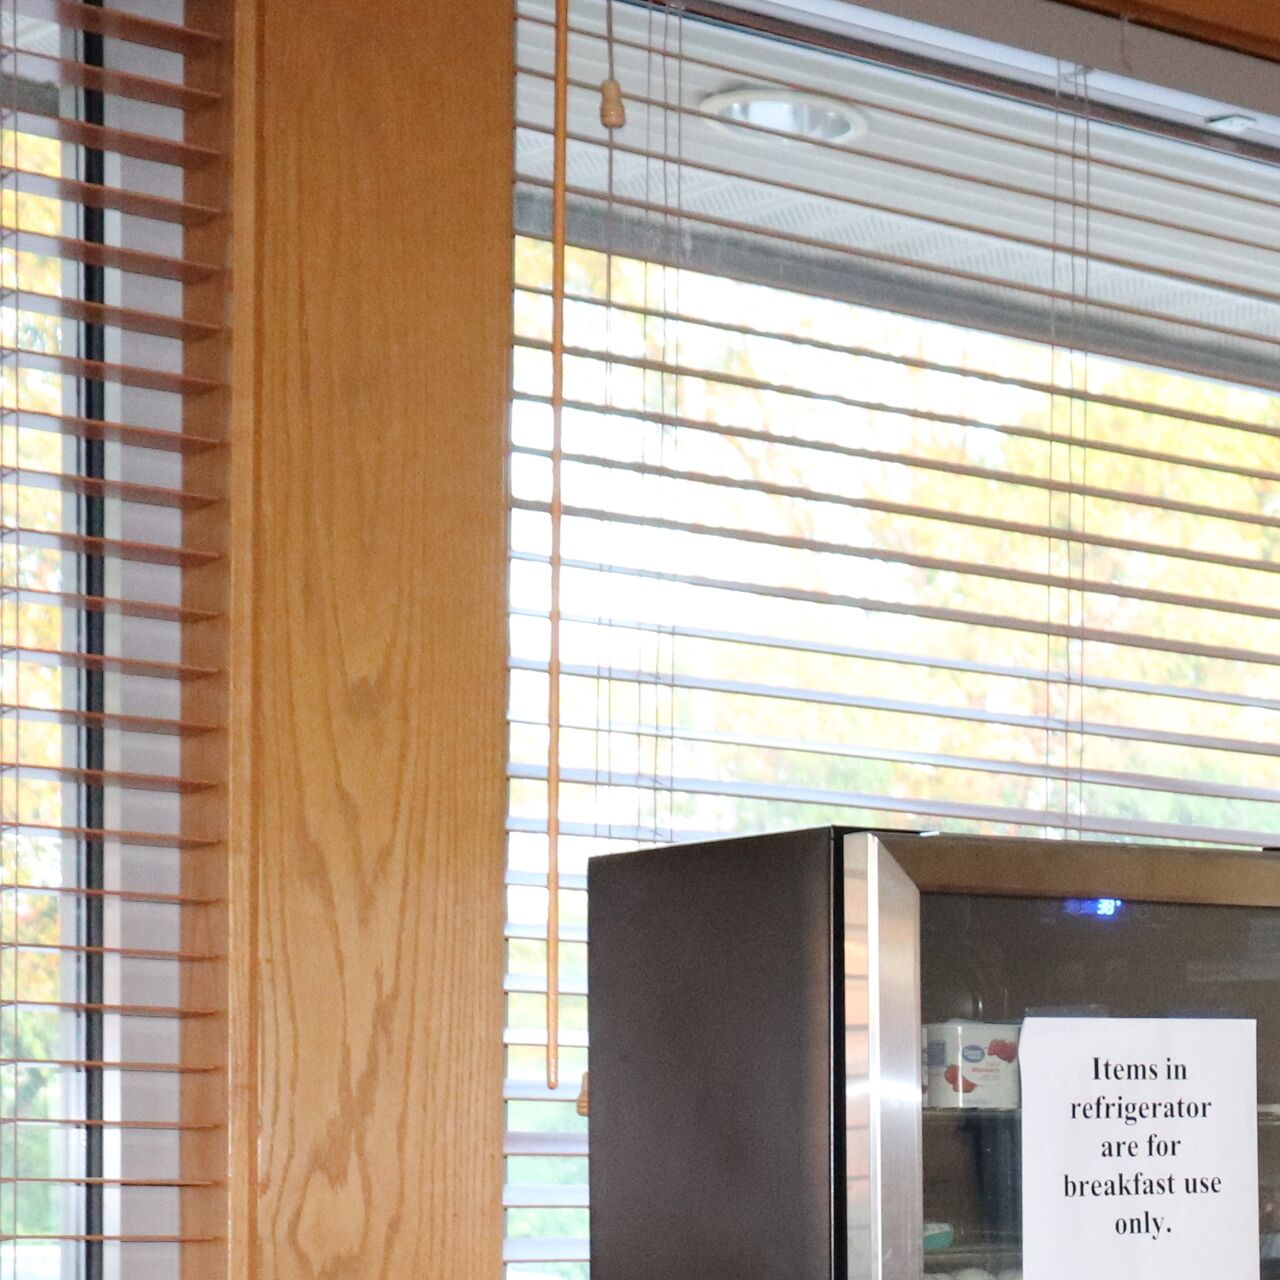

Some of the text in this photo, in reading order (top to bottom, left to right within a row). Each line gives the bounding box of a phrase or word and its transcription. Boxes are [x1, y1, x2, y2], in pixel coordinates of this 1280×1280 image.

[1092, 1057, 1188, 1081] Items in
[1071, 1095, 1212, 1125] refrigerator
[1101, 1133, 1182, 1158] are for
[1063, 1172, 1222, 1197] breakfast use
[1115, 1210, 1173, 1240] only.
